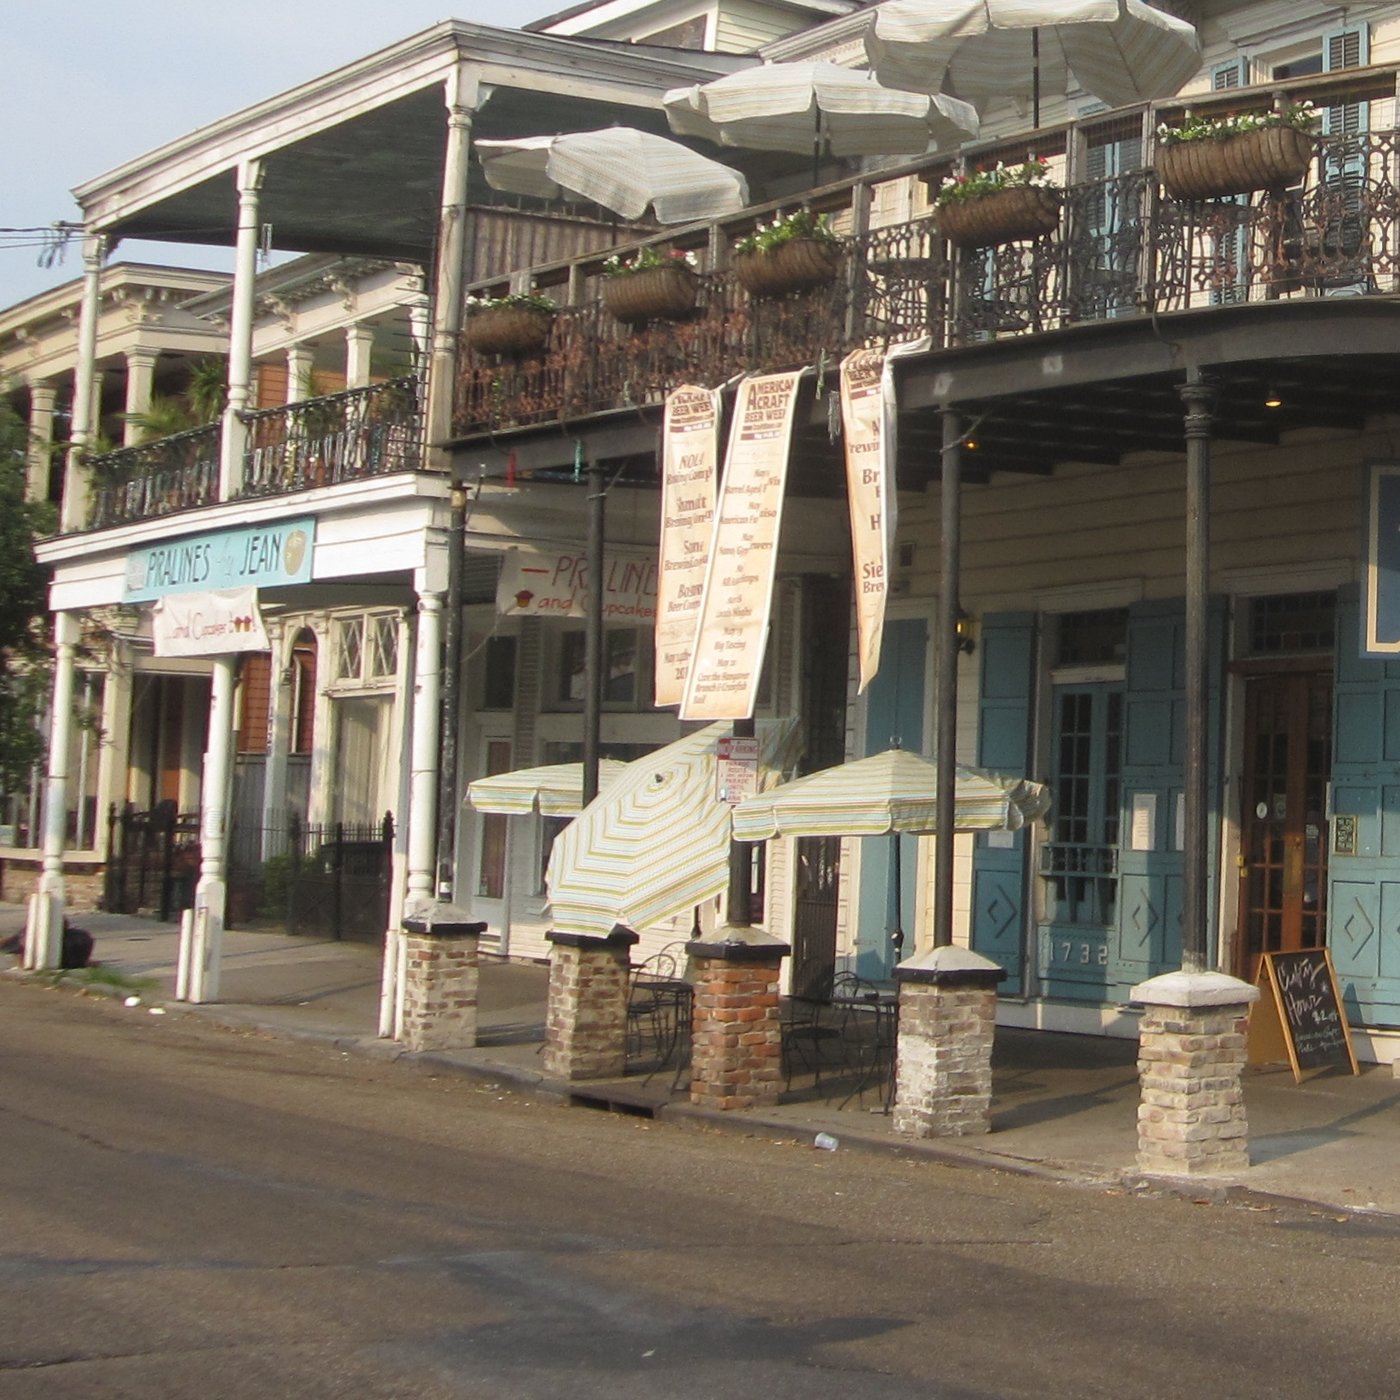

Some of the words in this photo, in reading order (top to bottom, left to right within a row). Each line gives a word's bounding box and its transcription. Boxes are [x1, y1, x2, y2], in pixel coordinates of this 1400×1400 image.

[672, 405, 690, 417] BEER
[757, 393, 790, 409] CRAFT
[744, 411, 764, 423] BEER
[145, 544, 211, 587] PRALINES
[239, 534, 282, 576] JEAN
[552, 556, 657, 596] PRLINE
[538, 585, 577, 610] and
[1050, 942, 1108, 965] 1732
